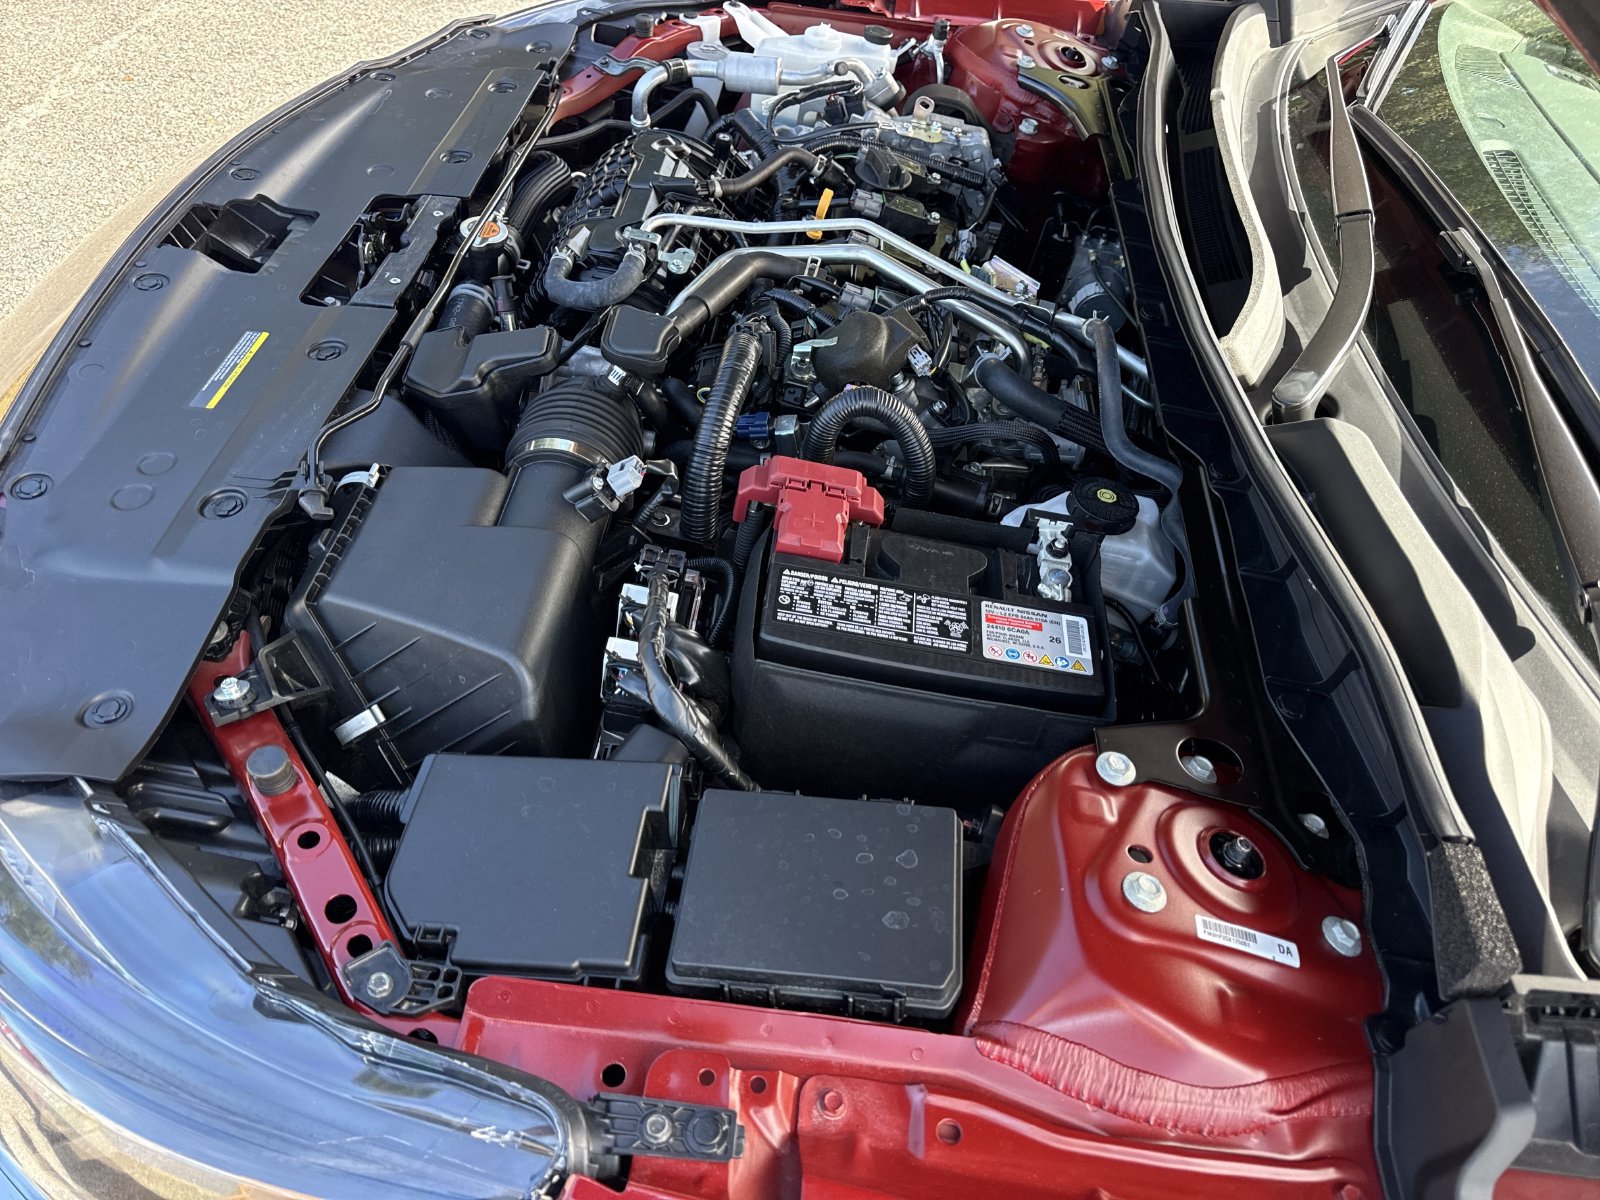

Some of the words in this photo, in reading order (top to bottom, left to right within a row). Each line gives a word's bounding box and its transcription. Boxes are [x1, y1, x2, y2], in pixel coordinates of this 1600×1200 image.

[985, 603, 1014, 613] RENAULT
[1017, 608, 1048, 618] NISSAN
[1048, 635, 1062, 644] 26
[1278, 943, 1293, 957] DA
